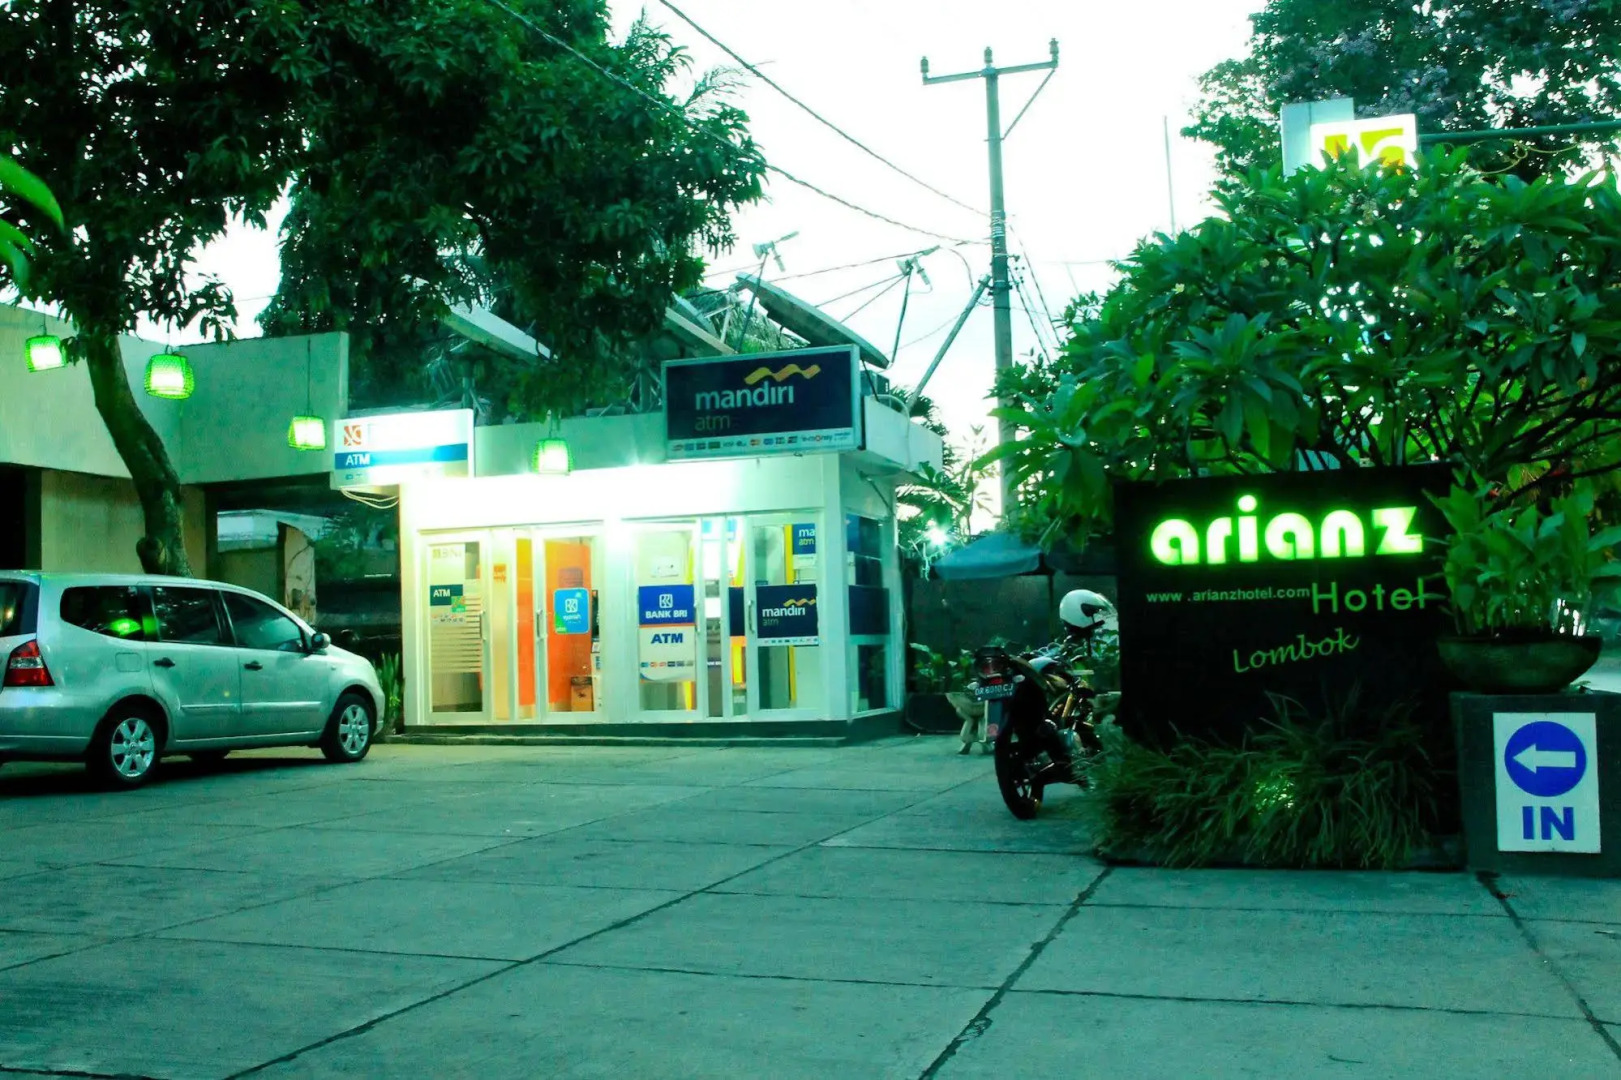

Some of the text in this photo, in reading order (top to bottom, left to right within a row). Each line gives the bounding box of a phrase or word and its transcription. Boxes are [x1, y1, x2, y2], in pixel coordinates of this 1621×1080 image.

[695, 380, 795, 410] mandiri
[694, 414, 730, 431] atm
[345, 453, 371, 467] ATM
[1150, 493, 1424, 566] arianz
[433, 589, 451, 598] ATM
[1311, 577, 1426, 614] Hotel
[645, 609, 688, 619] BANK BRI
[762, 605, 805, 617] mandiri
[651, 633, 683, 644] ATM
[1232, 627, 1360, 674] Lombok
[1521, 806, 1575, 841] IN
